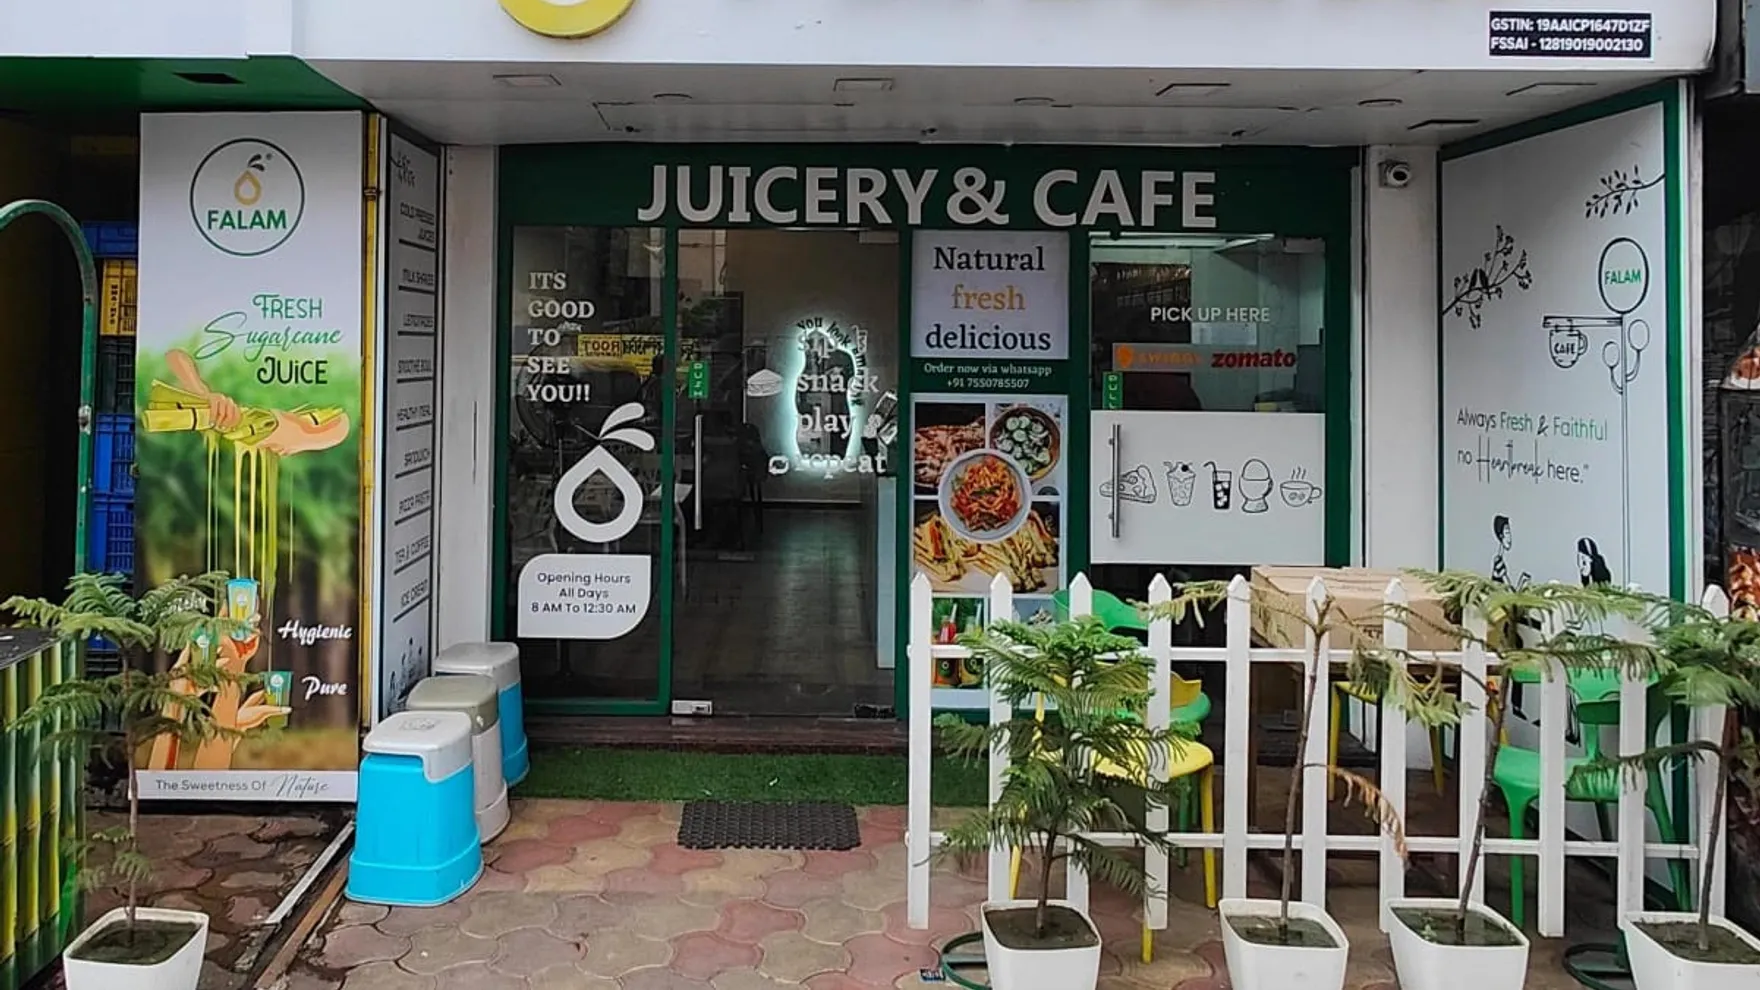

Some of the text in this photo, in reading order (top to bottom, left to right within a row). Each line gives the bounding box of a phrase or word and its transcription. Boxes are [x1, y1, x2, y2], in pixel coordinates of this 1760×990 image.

[1490, 18, 1534, 31] GSTIN:
[1490, 37, 1528, 50] FSSAI
[1539, 38, 1643, 51] 12819019002130
[637, 165, 1217, 228] JUICERY & CAFE
[207, 209, 287, 230] FALAM
[933, 246, 1045, 271] Natural
[1604, 270, 1642, 285] FALAM
[951, 284, 1026, 310] fresh
[253, 294, 323, 320] FRESH
[528, 300, 595, 319] GOOD
[1150, 307, 1271, 322] PICK UP HERE
[195, 311, 344, 363] Sugarcane
[528, 328, 561, 347] TO
[826, 320, 852, 348] look
[925, 323, 1052, 350] delicious
[1554, 342, 1576, 355] CAFE
[527, 356, 571, 375] SEE
[1211, 349, 1296, 368] zomato
[924, 363, 1052, 377] Order now via whatsapp
[797, 367, 879, 393] snack
[947, 377, 1030, 388] +91 7550785507
[527, 384, 591, 402] YOU!!
[798, 406, 857, 439] play
[1457, 408, 1608, 441] Always Fresh & Faithful
[795, 453, 888, 480] repeat
[1457, 449, 1473, 465] no
[537, 571, 632, 586] Opening Hours
[558, 587, 609, 600] All Days
[531, 602, 636, 614] 8 AM To 12:30 AM
[277, 619, 353, 646] Hygienic
[301, 676, 348, 701] Pure
[155, 773, 330, 799] The Sweetness Of Nature
